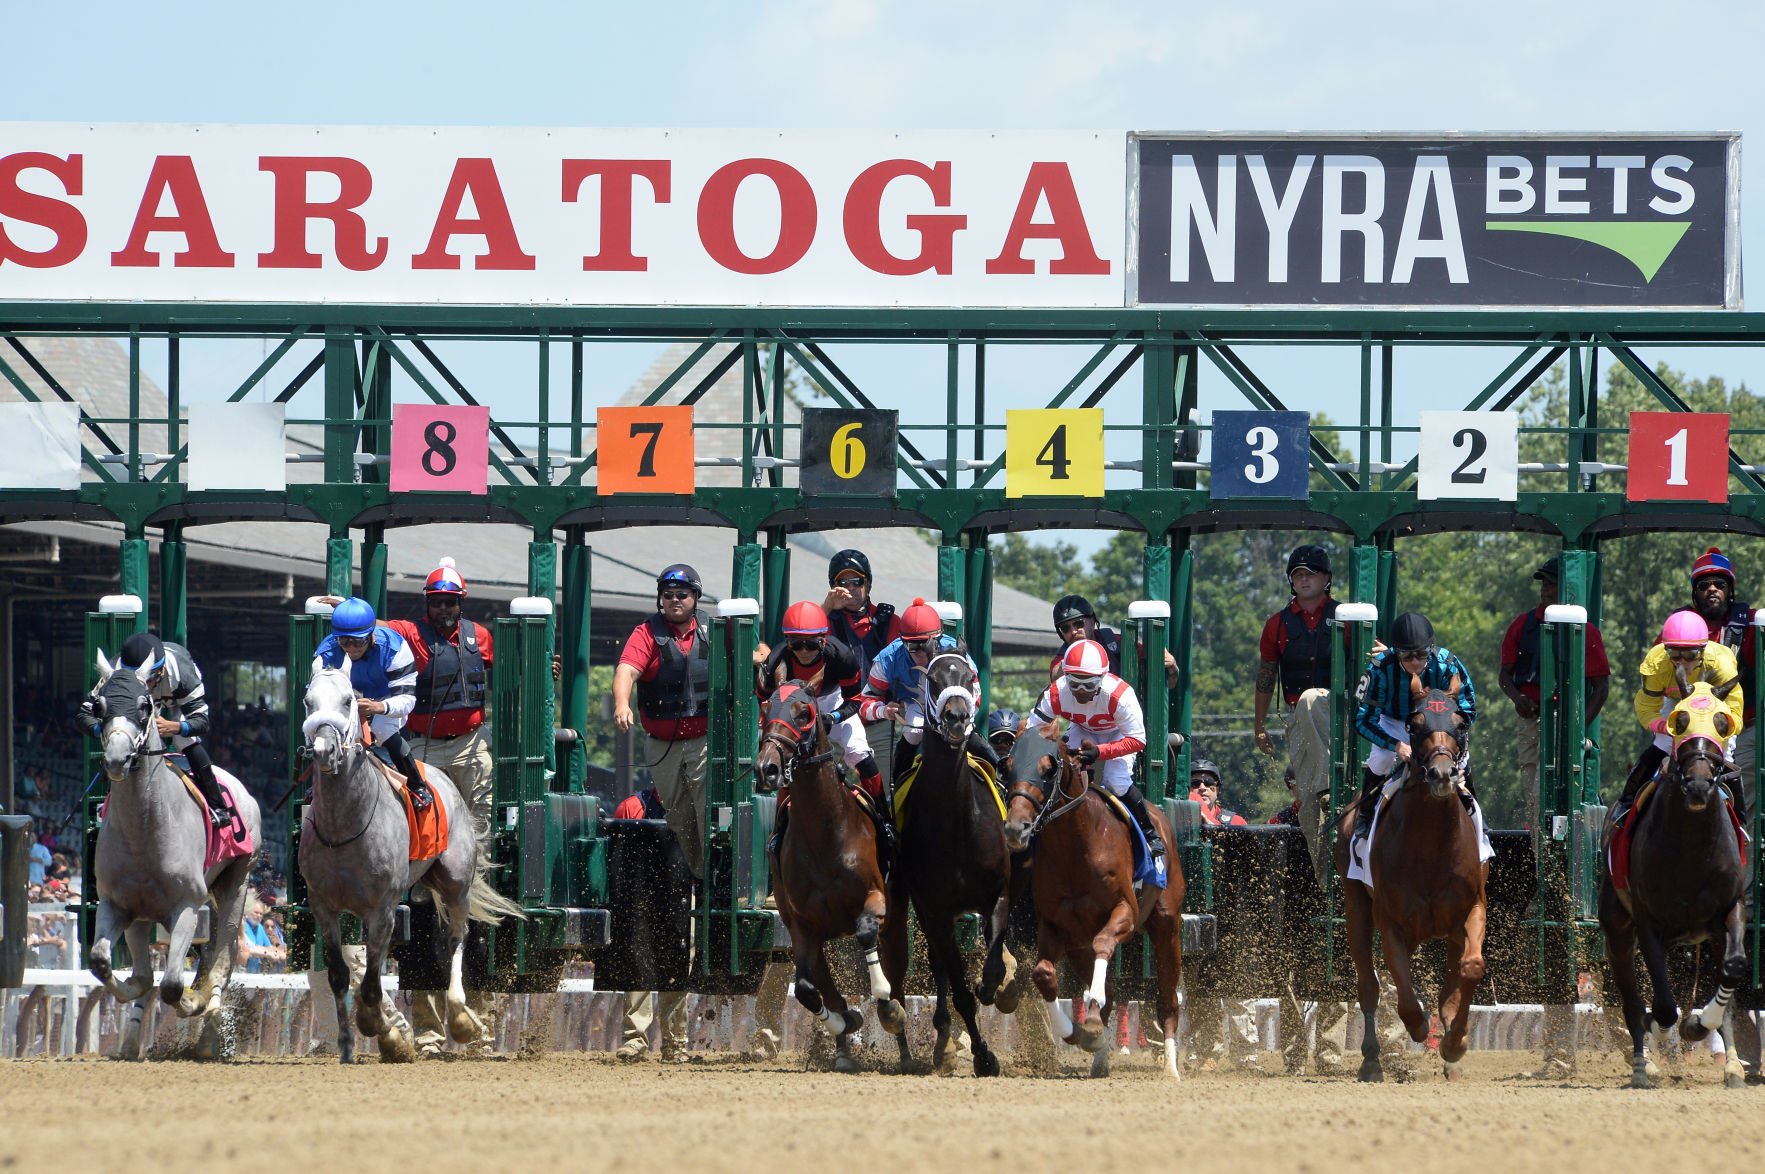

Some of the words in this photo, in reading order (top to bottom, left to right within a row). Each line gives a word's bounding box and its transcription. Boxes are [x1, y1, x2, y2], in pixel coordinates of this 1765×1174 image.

[0, 152, 1110, 275] SARATOGA
[1170, 155, 1469, 284] NYRA
[1486, 155, 1695, 217] BETS
[421, 420, 457, 477] 8
[629, 422, 664, 478] 7
[829, 422, 867, 480] 6
[1035, 424, 1072, 480] 4
[1244, 426, 1280, 484] 3
[1451, 428, 1487, 484] 2
[1664, 428, 1689, 486] 1
[1355, 675, 1367, 700] 2
